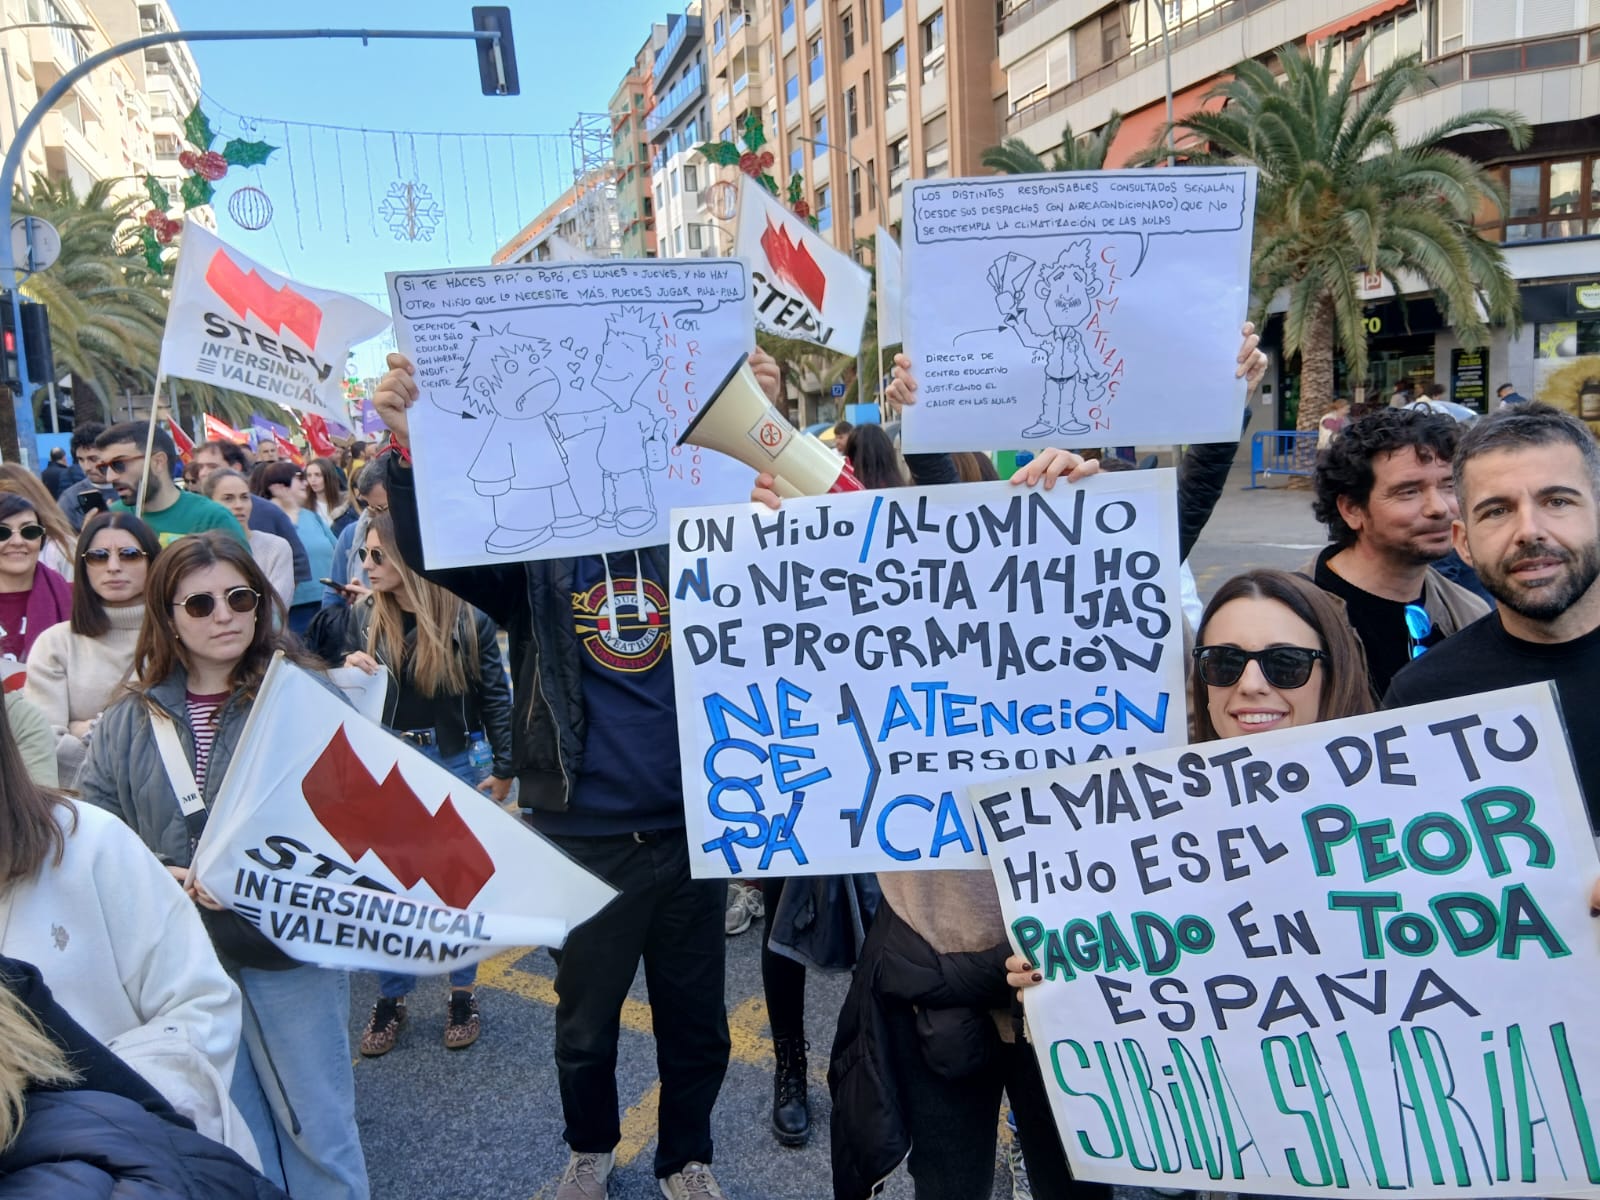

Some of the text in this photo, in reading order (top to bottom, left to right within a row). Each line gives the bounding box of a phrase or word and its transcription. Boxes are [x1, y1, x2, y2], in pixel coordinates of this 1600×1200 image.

[922, 192, 940, 201] LOS
[1018, 182, 1099, 196] RESPONSABLES
[1110, 182, 1177, 192] CONSULTADOS
[960, 207, 977, 217] SUS
[982, 202, 1040, 215] DESPACHOS
[1046, 202, 1064, 213] CON
[1180, 201, 1203, 212] QUE
[1208, 200, 1228, 213] NO
[922, 226, 935, 236] SE
[938, 222, 992, 234] CONTEMPLA
[996, 220, 1009, 231] LA
[1102, 218, 1116, 228] DE
[1119, 216, 1137, 226] LAS
[1142, 216, 1171, 226] AULAS
[422, 280, 438, 290] TE
[447, 276, 486, 289] HACES
[572, 270, 588, 280] ES
[593, 268, 628, 279] LUNES
[684, 270, 690, 280] Y
[694, 270, 706, 280] NO
[710, 270, 729, 280] HAY
[406, 300, 436, 310] OTRO
[474, 295, 497, 306] QUE
[500, 292, 510, 302] LO
[612, 286, 652, 298] PUEDES
[656, 286, 692, 297] JUGAR
[412, 322, 456, 332] DEPENDE
[414, 334, 428, 342] DE
[204, 312, 333, 383] STEPV
[416, 342, 458, 354] EDUCADOR
[416, 356, 432, 366] CON
[925, 369, 960, 378] CENTRO
[926, 400, 956, 408] CALOR
[974, 398, 988, 406] LAS
[991, 396, 1017, 406] AULAS
[677, 516, 734, 552] UN
[988, 554, 1076, 615] 114
[682, 618, 746, 668] DE
[888, 744, 1136, 775] PERSONA
[979, 714, 1539, 843] EL MAESTRO DE TU
[876, 790, 988, 862] CA
[1130, 834, 1210, 896] ES
[1217, 824, 1289, 883] EL
[1302, 784, 1556, 883] PEOR
[234, 868, 492, 941] INTERSINDICAL
[1010, 882, 1572, 982] PAGADO EN TODA
[1094, 968, 1482, 1032] ESPAÑA
